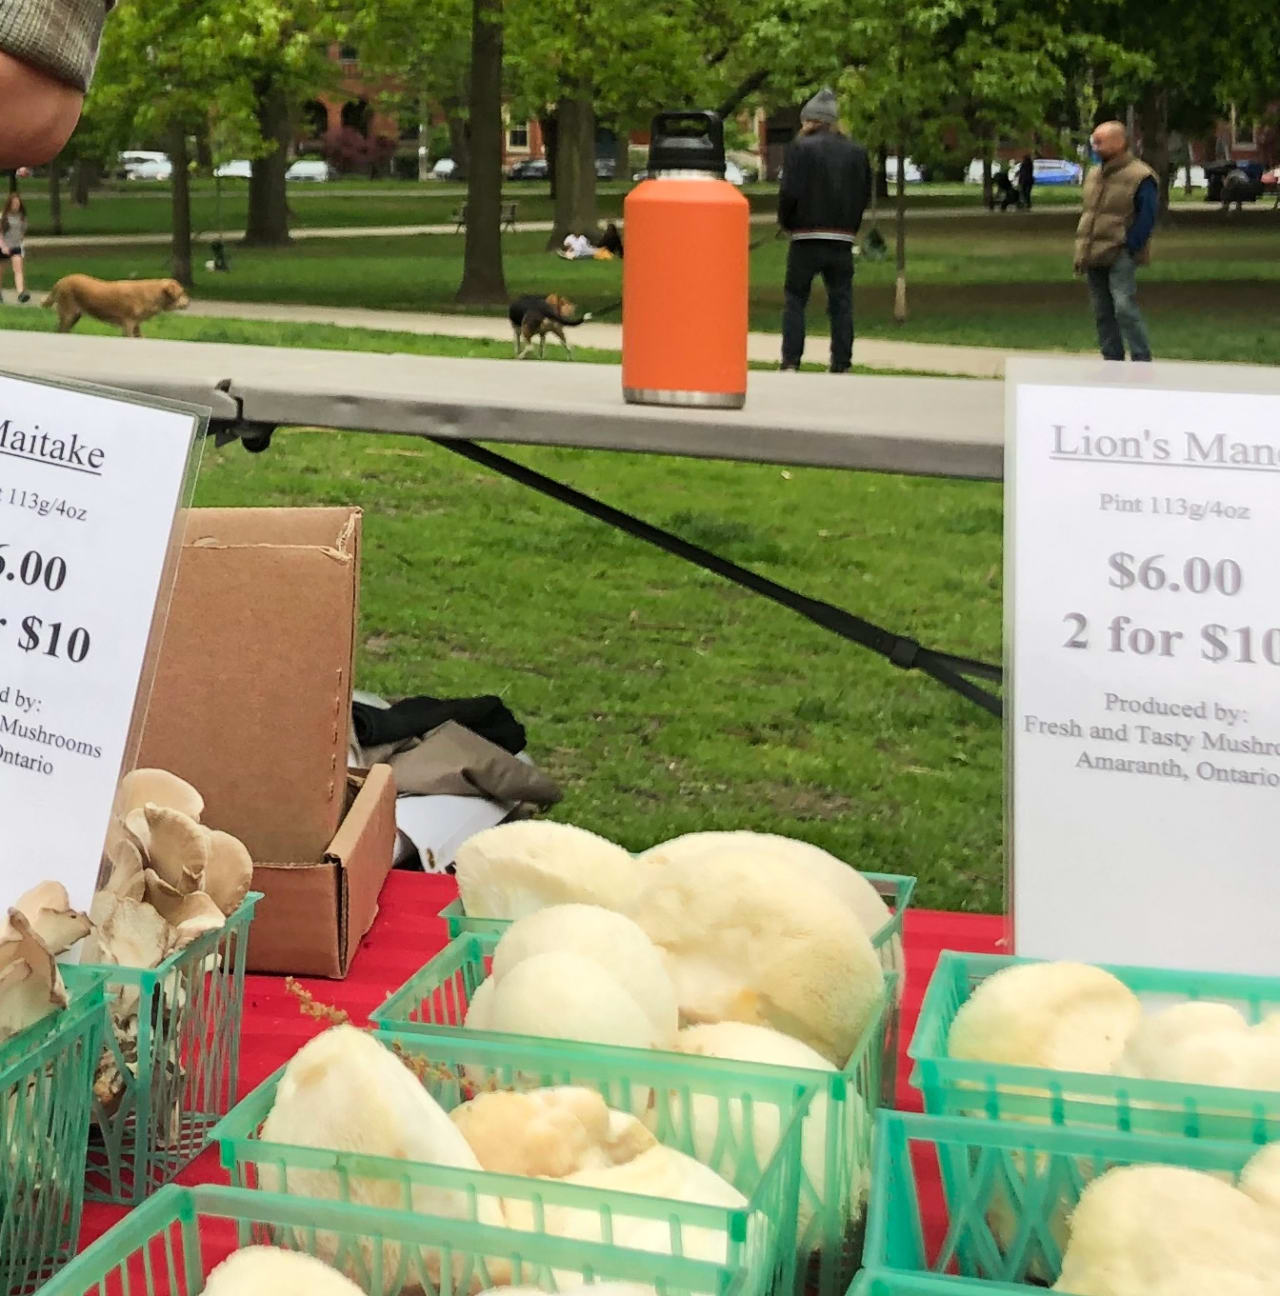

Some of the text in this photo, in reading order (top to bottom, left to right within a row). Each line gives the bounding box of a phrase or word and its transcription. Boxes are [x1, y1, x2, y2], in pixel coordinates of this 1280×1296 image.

[1051, 424, 1280, 467] Lion's Man
[9, 487, 88, 522] 113g/4oz
[1099, 493, 1251, 521] Pint 113g/4oz
[1107, 551, 1242, 597] $6.00
[16, 614, 91, 664] $10
[1062, 612, 1280, 666] 2 for $10
[15, 689, 42, 713] by:
[1104, 692, 1248, 725] Produced by:
[1024, 714, 1082, 740] Fresh
[1090, 722, 1128, 743] and
[1134, 724, 1195, 753] Tasty
[1075, 751, 1279, 788] Amaranth, Ontario
